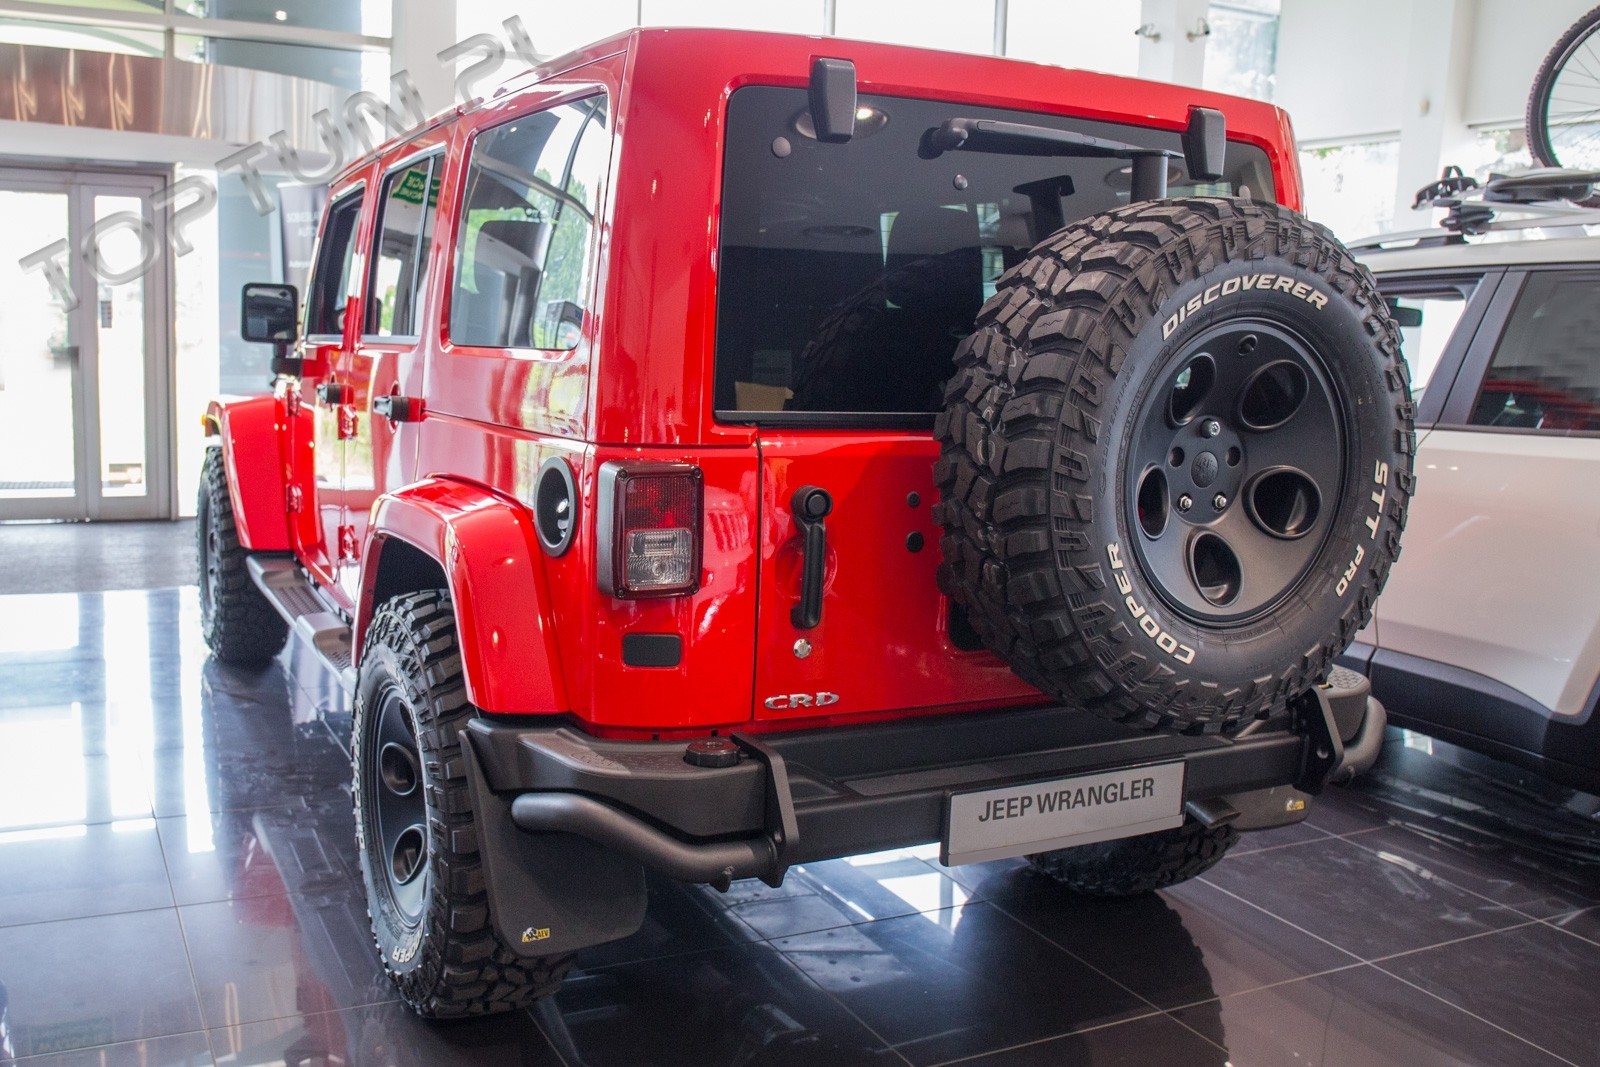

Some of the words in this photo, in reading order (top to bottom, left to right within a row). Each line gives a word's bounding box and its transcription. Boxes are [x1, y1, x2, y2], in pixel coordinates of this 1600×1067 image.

[1161, 273, 1329, 341] DISCOVERER
[1365, 459, 1389, 540] STT
[1335, 543, 1365, 597] PRO
[1107, 543, 1196, 664] COOPER
[764, 691, 840, 710] CRD
[978, 796, 1033, 822] JEEP
[1036, 777, 1155, 814] WRANGLER
[537, 929, 549, 938] AEV
